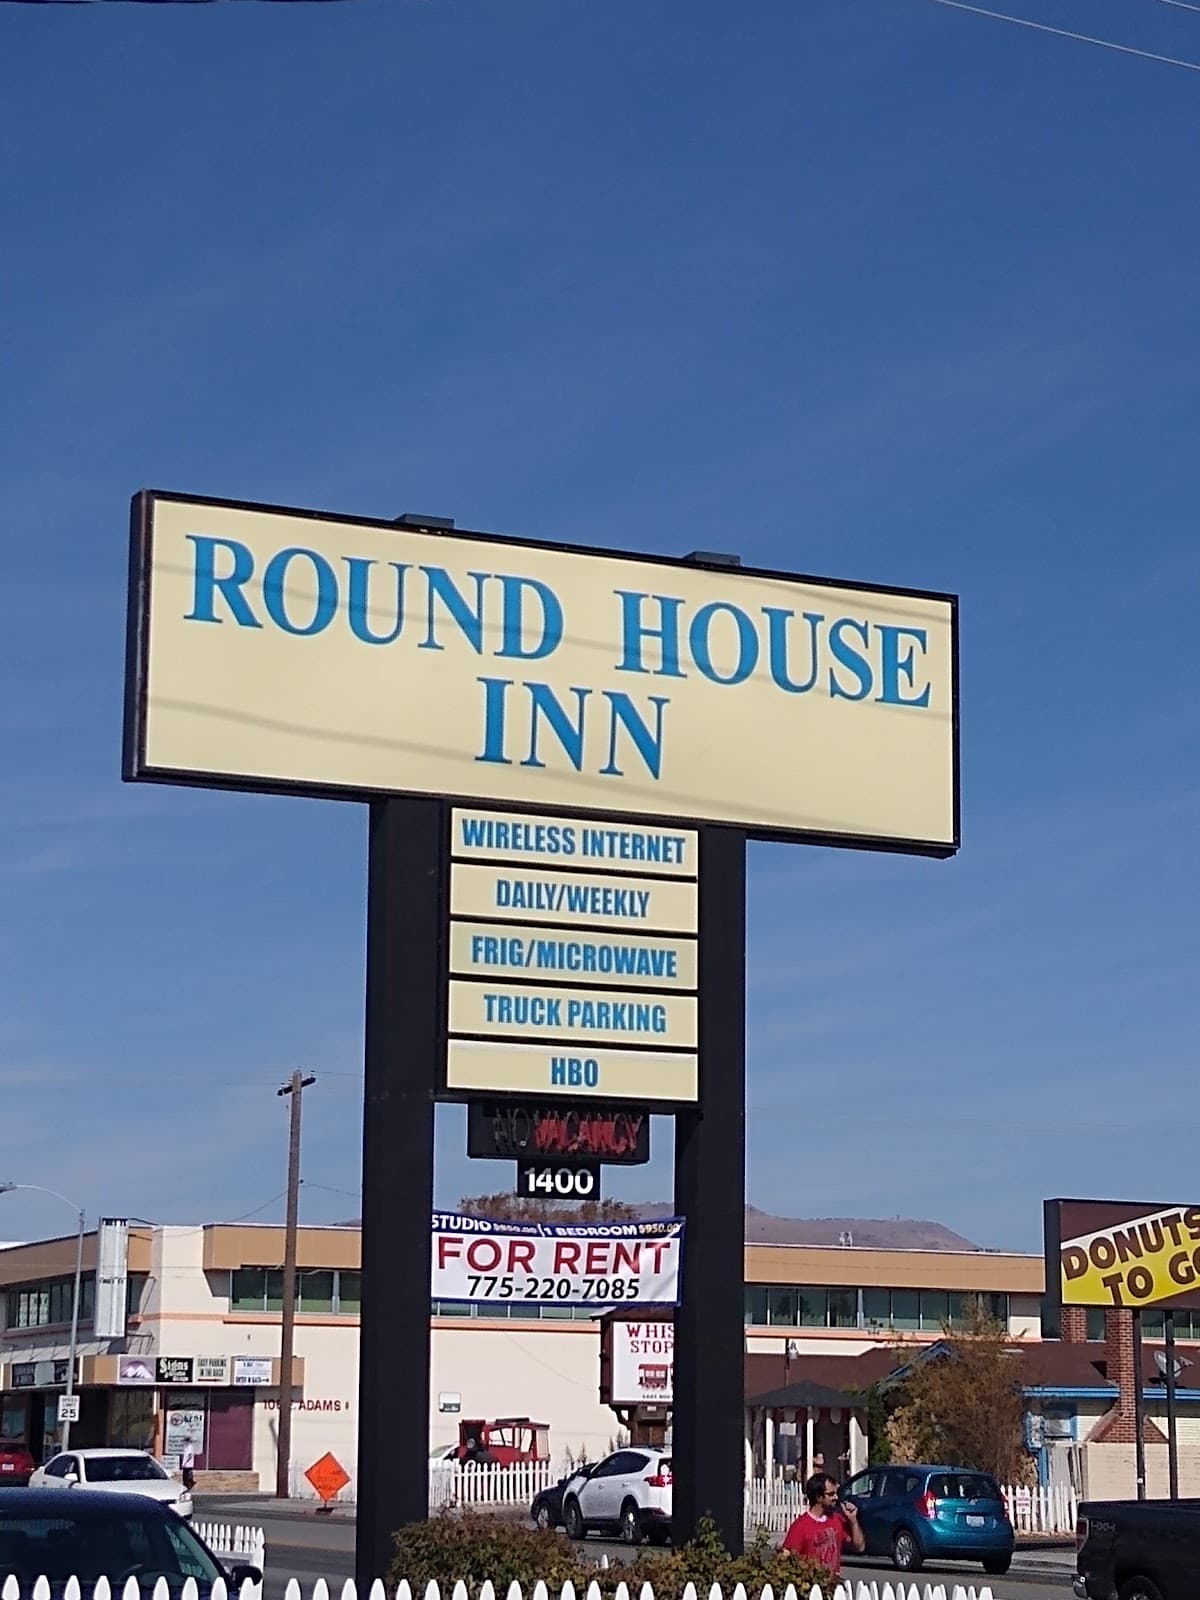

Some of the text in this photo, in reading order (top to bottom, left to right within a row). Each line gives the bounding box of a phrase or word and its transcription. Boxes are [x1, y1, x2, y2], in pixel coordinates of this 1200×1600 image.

[183, 534, 931, 708] ROUND HOUSE
[474, 677, 671, 780] INN
[462, 818, 686, 864] WIRELESS INTERNET
[496, 879, 650, 918] DAILY/WEEKLY
[471, 935, 678, 978] FRIG/MICROWAVE
[483, 994, 666, 1033] TRUCK PARKING
[550, 1057, 599, 1087] HBO
[493, 1107, 643, 1154] NO VACANCY
[525, 1167, 594, 1194] 1400
[431, 1214, 492, 1232] STUDIO
[555, 1225, 637, 1236] BEDROOM
[1061, 1208, 1200, 1281] DONUTS
[437, 1235, 671, 1275] FOR RENT
[1101, 1244, 1200, 1305] TO G
[467, 1275, 640, 1299] 775-220-7085
[630, 1340, 674, 1354] STOP
[61, 1408, 76, 1418] 25
[298, 1399, 342, 1411] ADAMS
